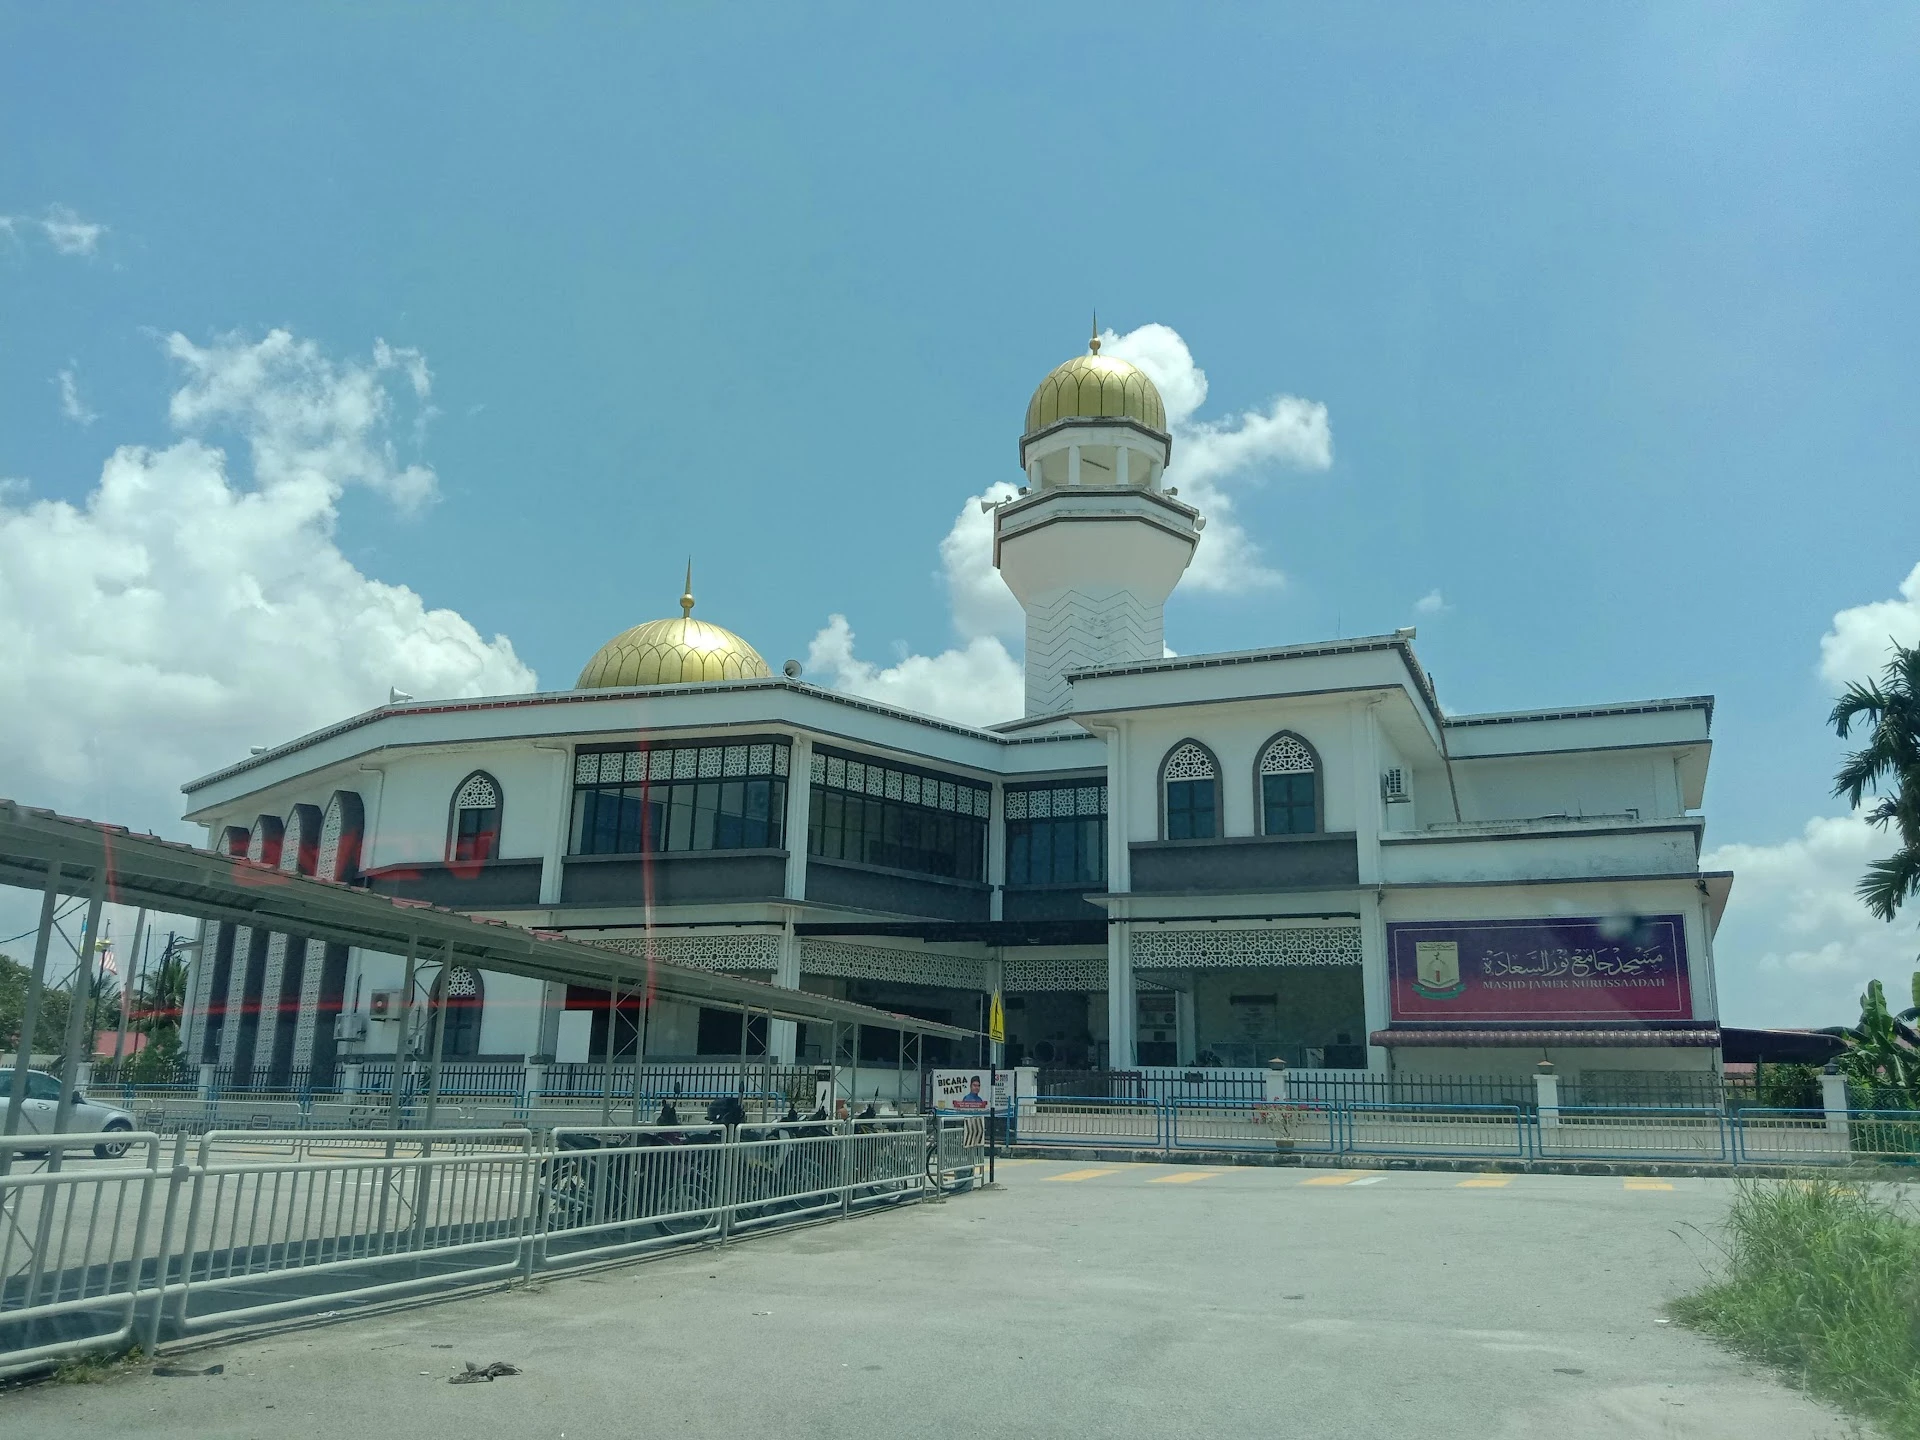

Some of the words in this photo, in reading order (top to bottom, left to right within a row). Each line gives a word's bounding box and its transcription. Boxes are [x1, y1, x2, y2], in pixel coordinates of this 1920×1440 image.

[1483, 981, 1525, 989] MASJID
[1529, 980, 1569, 989] JAMEK
[1572, 979, 1665, 988] NURUSSAADAH
